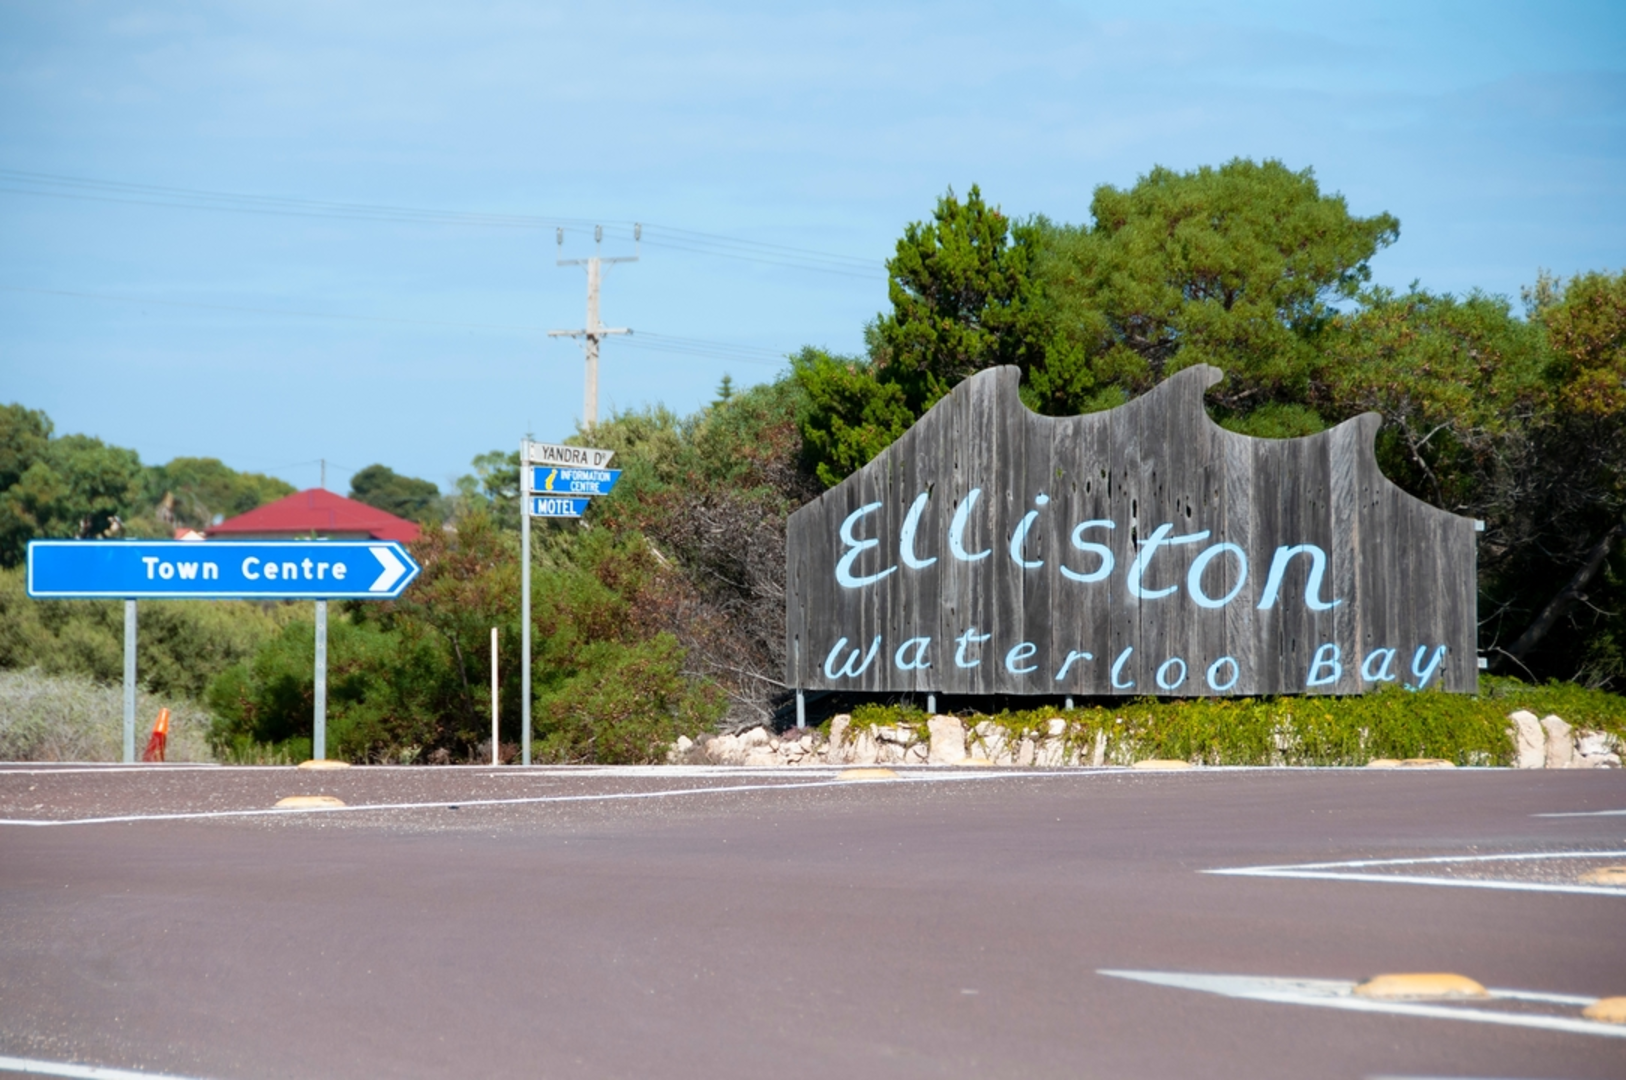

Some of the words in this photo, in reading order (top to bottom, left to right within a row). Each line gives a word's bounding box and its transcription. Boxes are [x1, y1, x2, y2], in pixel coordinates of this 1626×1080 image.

[542, 446, 588, 464] YANDRA
[560, 469, 611, 482] INFORMATION
[570, 481, 600, 493] CENTRE
[537, 499, 577, 515] MOTEL
[835, 488, 1342, 611] Elliston
[142, 556, 219, 580] Town
[241, 556, 348, 580] Centre
[1306, 642, 1447, 692] Bay
